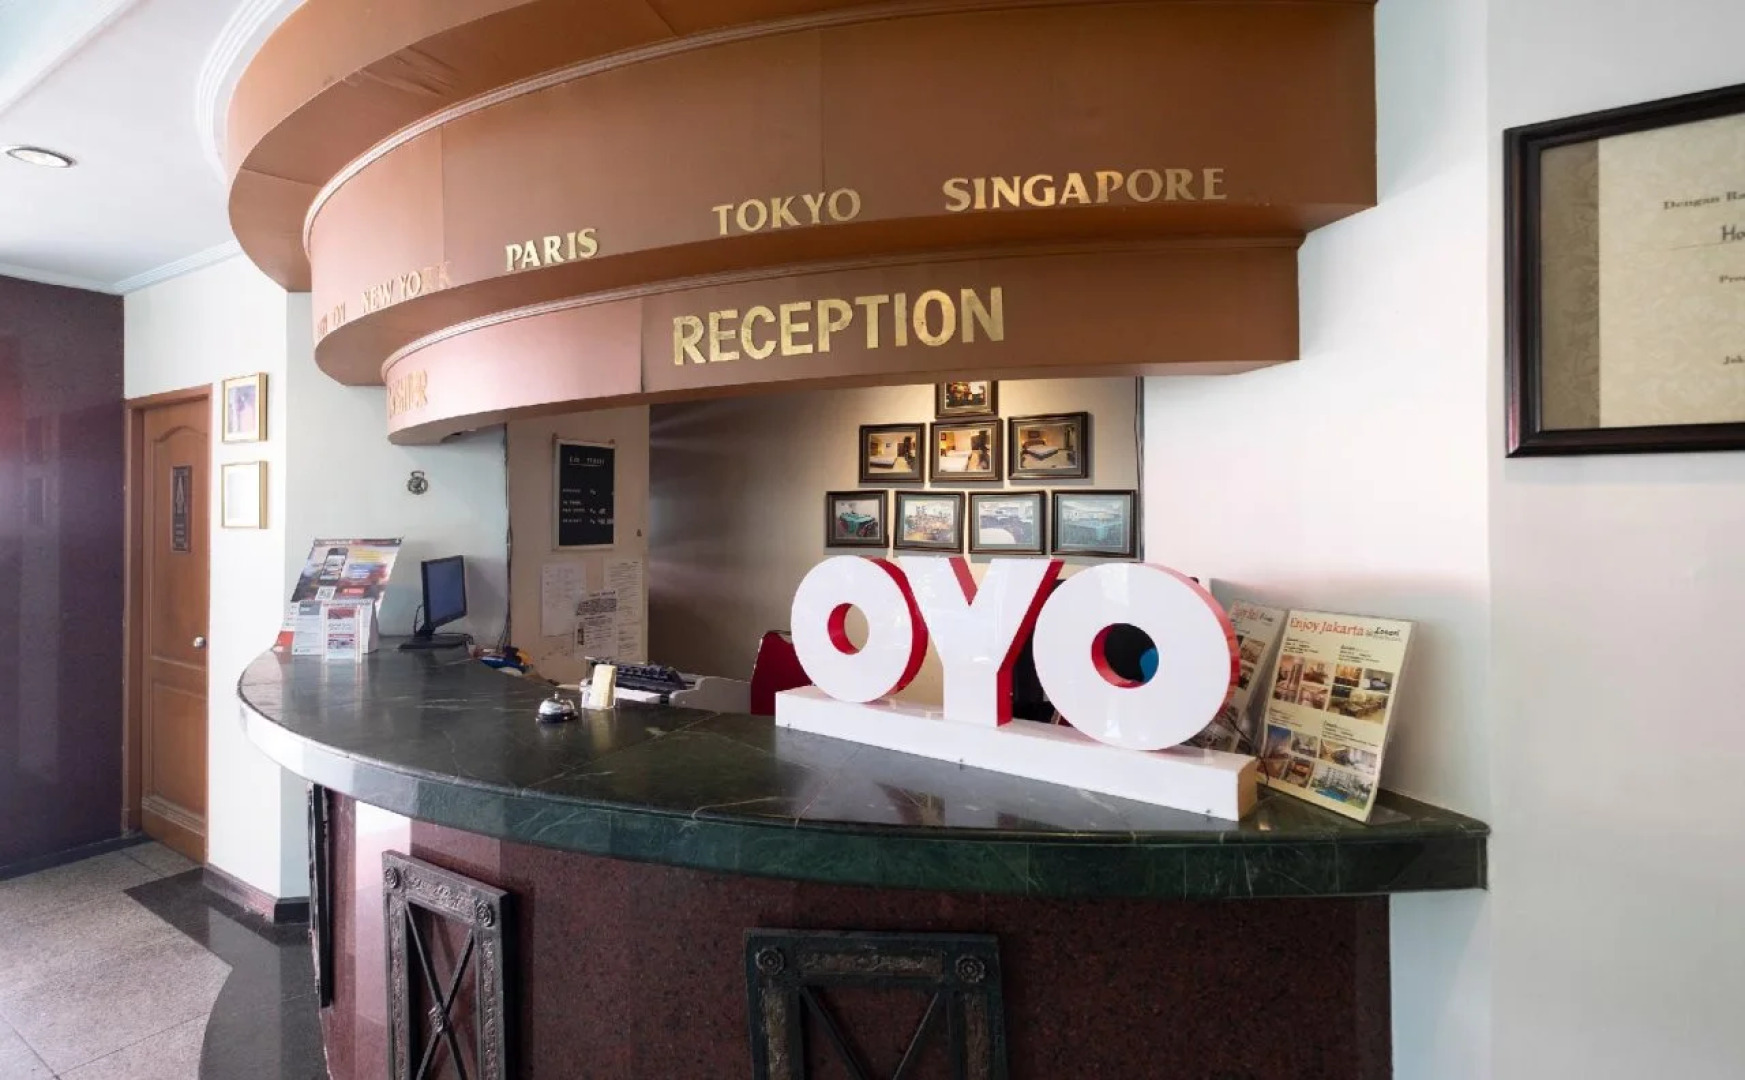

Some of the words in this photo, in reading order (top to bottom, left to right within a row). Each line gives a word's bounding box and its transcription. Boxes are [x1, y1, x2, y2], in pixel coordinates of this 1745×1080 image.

[712, 188, 861, 235] TOKYO
[942, 168, 1228, 212] SINGAPORE
[505, 228, 599, 272] PARIS
[673, 287, 1005, 366] RECEPTION
[1290, 617, 1321, 632] Enjoy
[1319, 620, 1365, 637] Jakarta
[791, 554, 1240, 752] OYO
